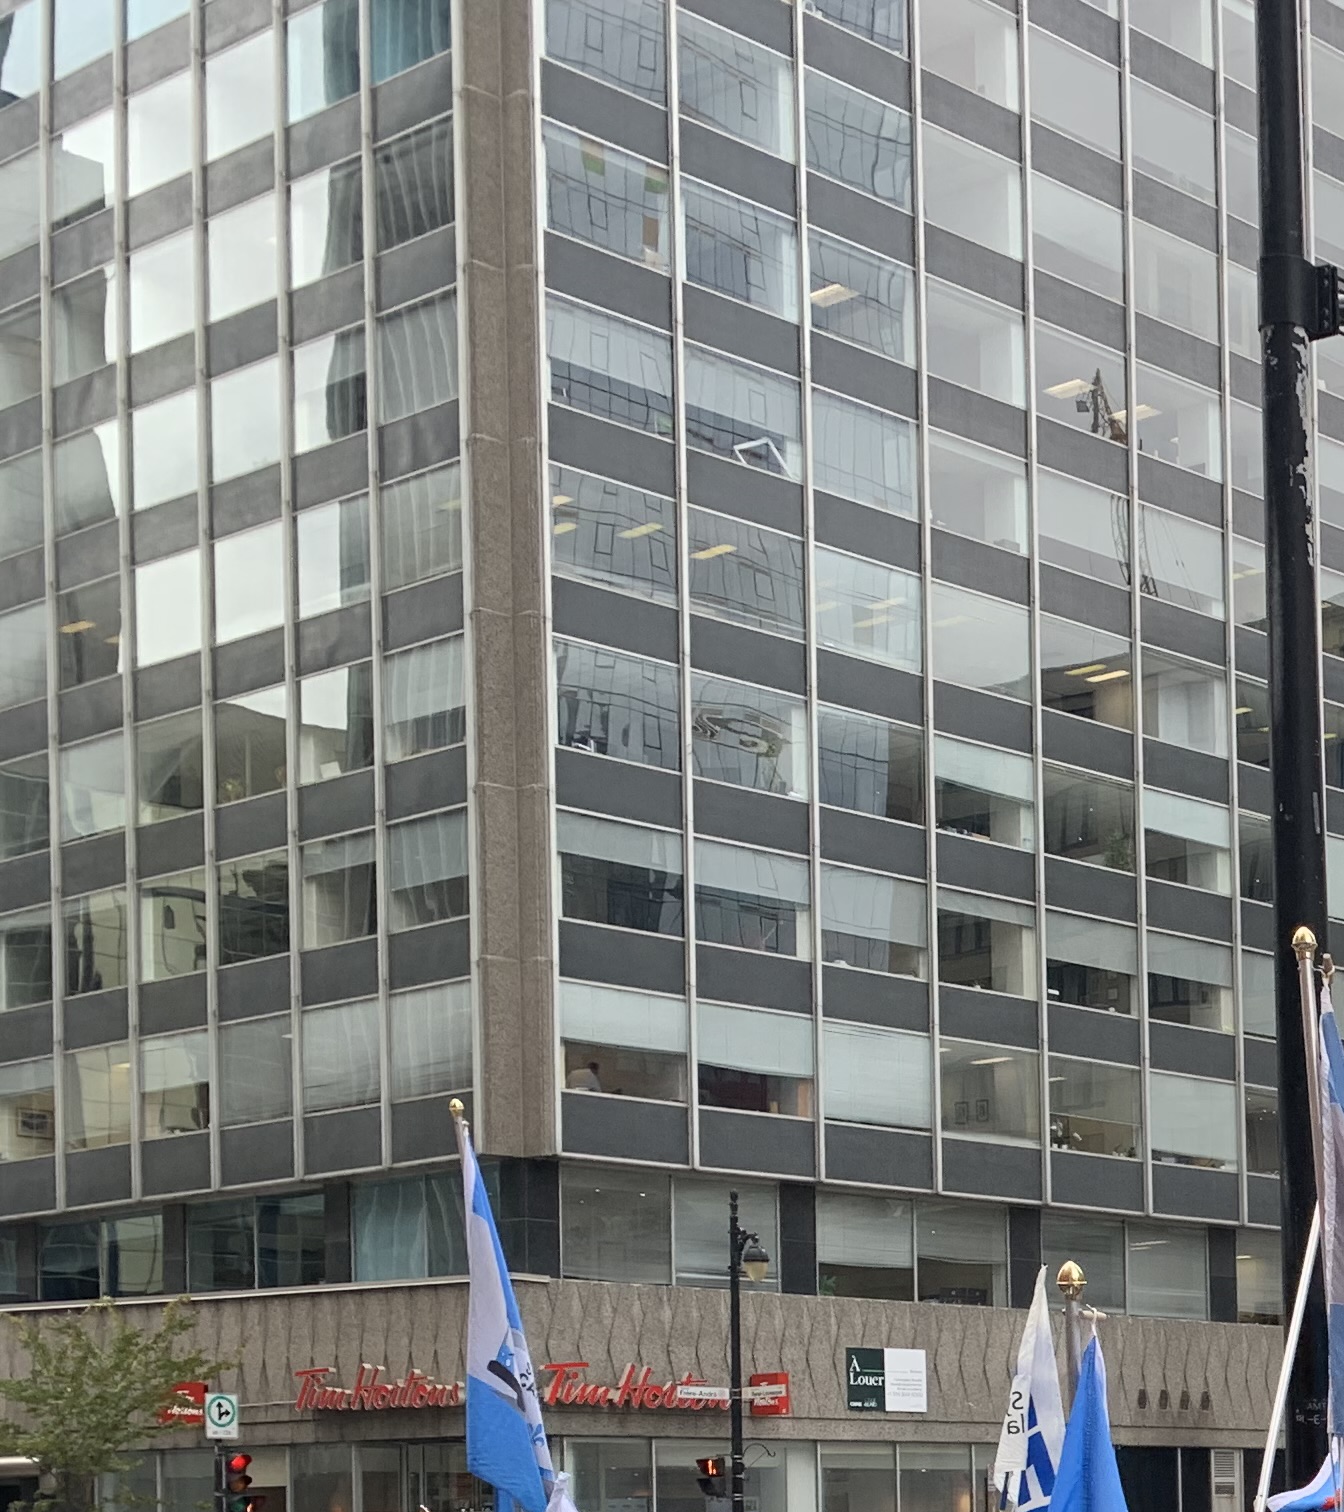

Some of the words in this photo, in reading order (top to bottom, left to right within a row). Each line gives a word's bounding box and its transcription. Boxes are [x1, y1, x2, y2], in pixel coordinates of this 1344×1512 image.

[849, 1354, 861, 1372] À
[849, 1372, 885, 1386] Louer
[295, 1367, 352, 1411] Tim
[350, 1363, 465, 1411] Hortons
[538, 1361, 610, 1407] Tim
